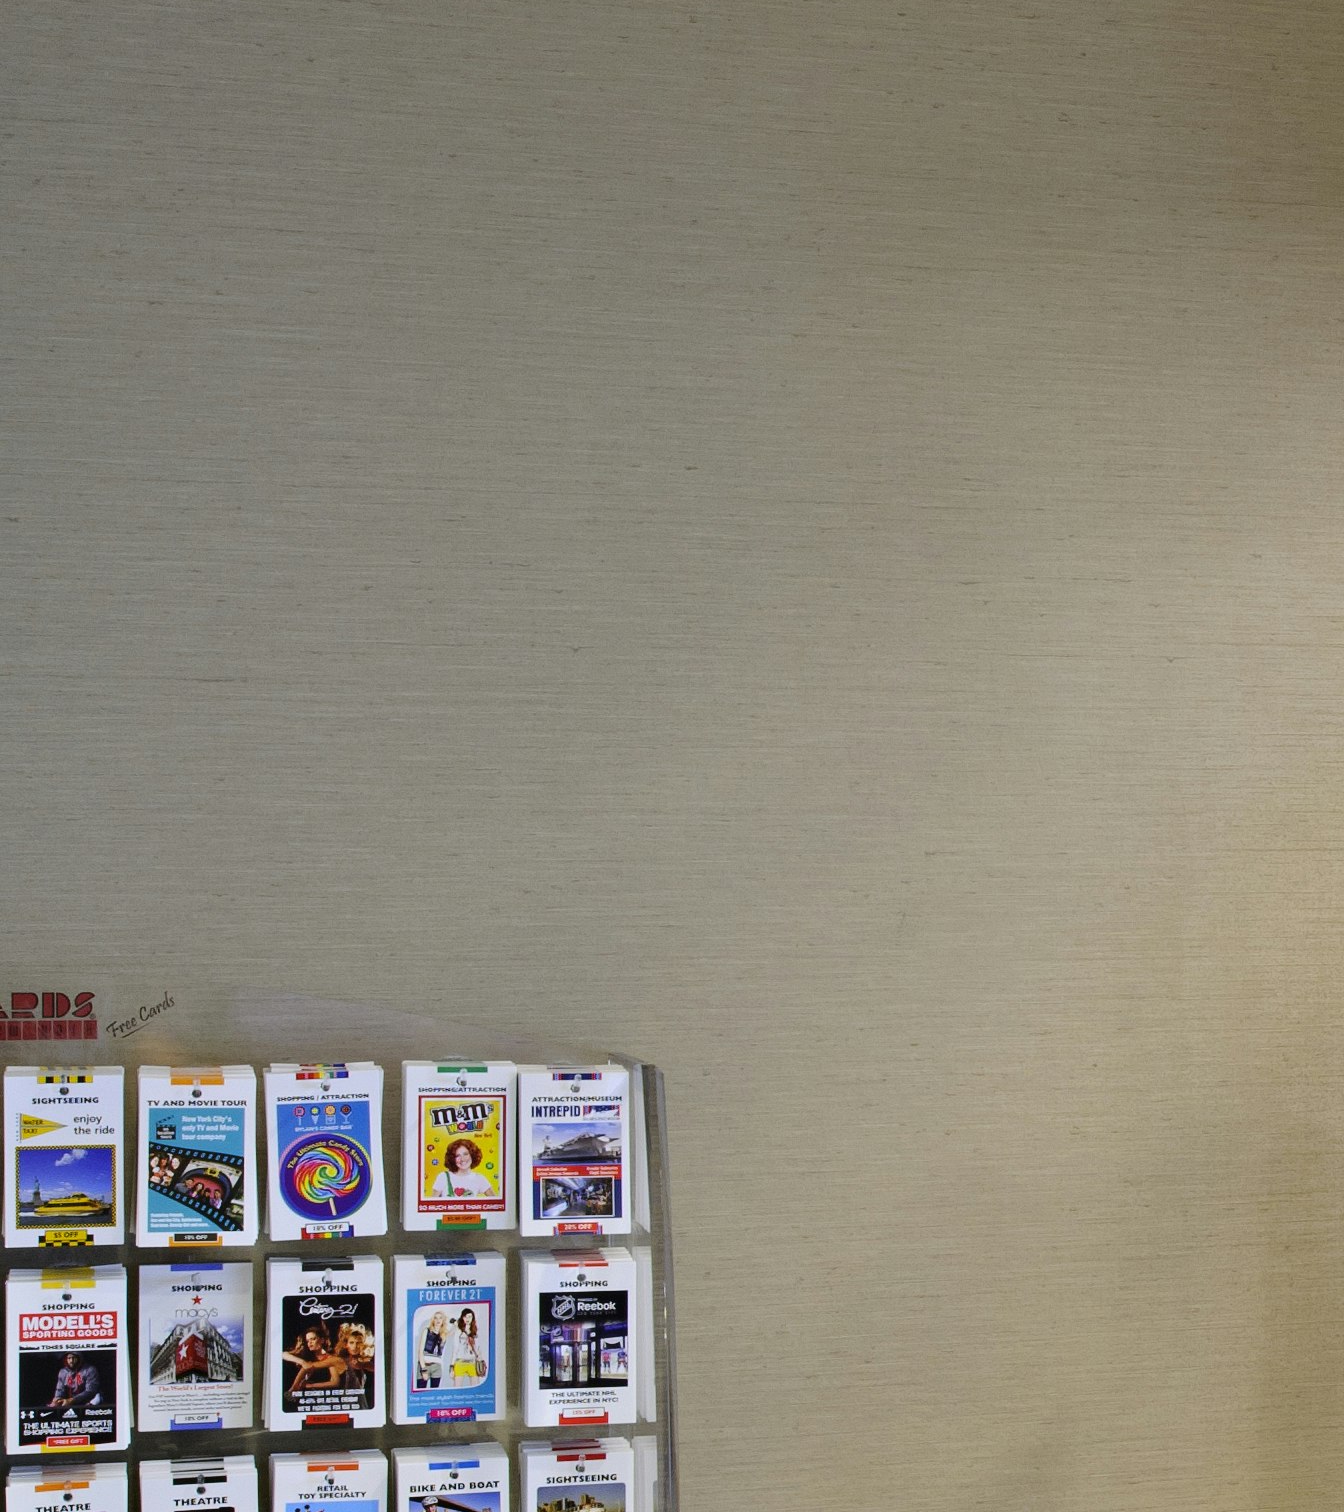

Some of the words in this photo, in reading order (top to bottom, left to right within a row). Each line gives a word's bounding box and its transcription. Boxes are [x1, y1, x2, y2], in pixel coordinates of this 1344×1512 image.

[106, 1017, 138, 1038] Free
[139, 991, 176, 1023] Cards
[32, 1096, 99, 1106] SIGHTSEEING
[531, 1105, 580, 1118] INTREPID
[74, 1114, 102, 1126] enjoy
[182, 1115, 197, 1123] New
[198, 1115, 213, 1123] York
[74, 1125, 92, 1135] the
[95, 1125, 115, 1136] ride
[220, 1124, 240, 1132] Movie
[63, 1231, 79, 1239] OFF
[426, 1278, 477, 1287] SHOPPING
[559, 1280, 609, 1288] SHOPPING
[299, 1284, 358, 1293] SHOPPING
[419, 1290, 468, 1301] FOREVER
[469, 1289, 480, 1299] 21
[42, 1303, 96, 1311] SHOPPING
[577, 1301, 617, 1311] Reebok
[175, 1307, 218, 1319] macy's
[22, 1314, 114, 1331] MODELL'S
[22, 1330, 75, 1339] SPORTING
[77, 1329, 114, 1337] GOODS
[451, 1408, 467, 1416] OFF
[23, 1422, 39, 1430] THE
[40, 1421, 80, 1429] ULTIMATE
[82, 1420, 113, 1428] SPORTS
[23, 1429, 63, 1437] SHOPPING
[65, 1427, 113, 1435] EXPERIENCE
[546, 1474, 617, 1484] SIGHTSEEING
[409, 1484, 436, 1492] BIKE
[439, 1482, 466, 1490] AND
[469, 1481, 500, 1489] BOAT
[319, 1491, 367, 1499] SPECIALTY
[174, 1496, 228, 1507] THEATRE
